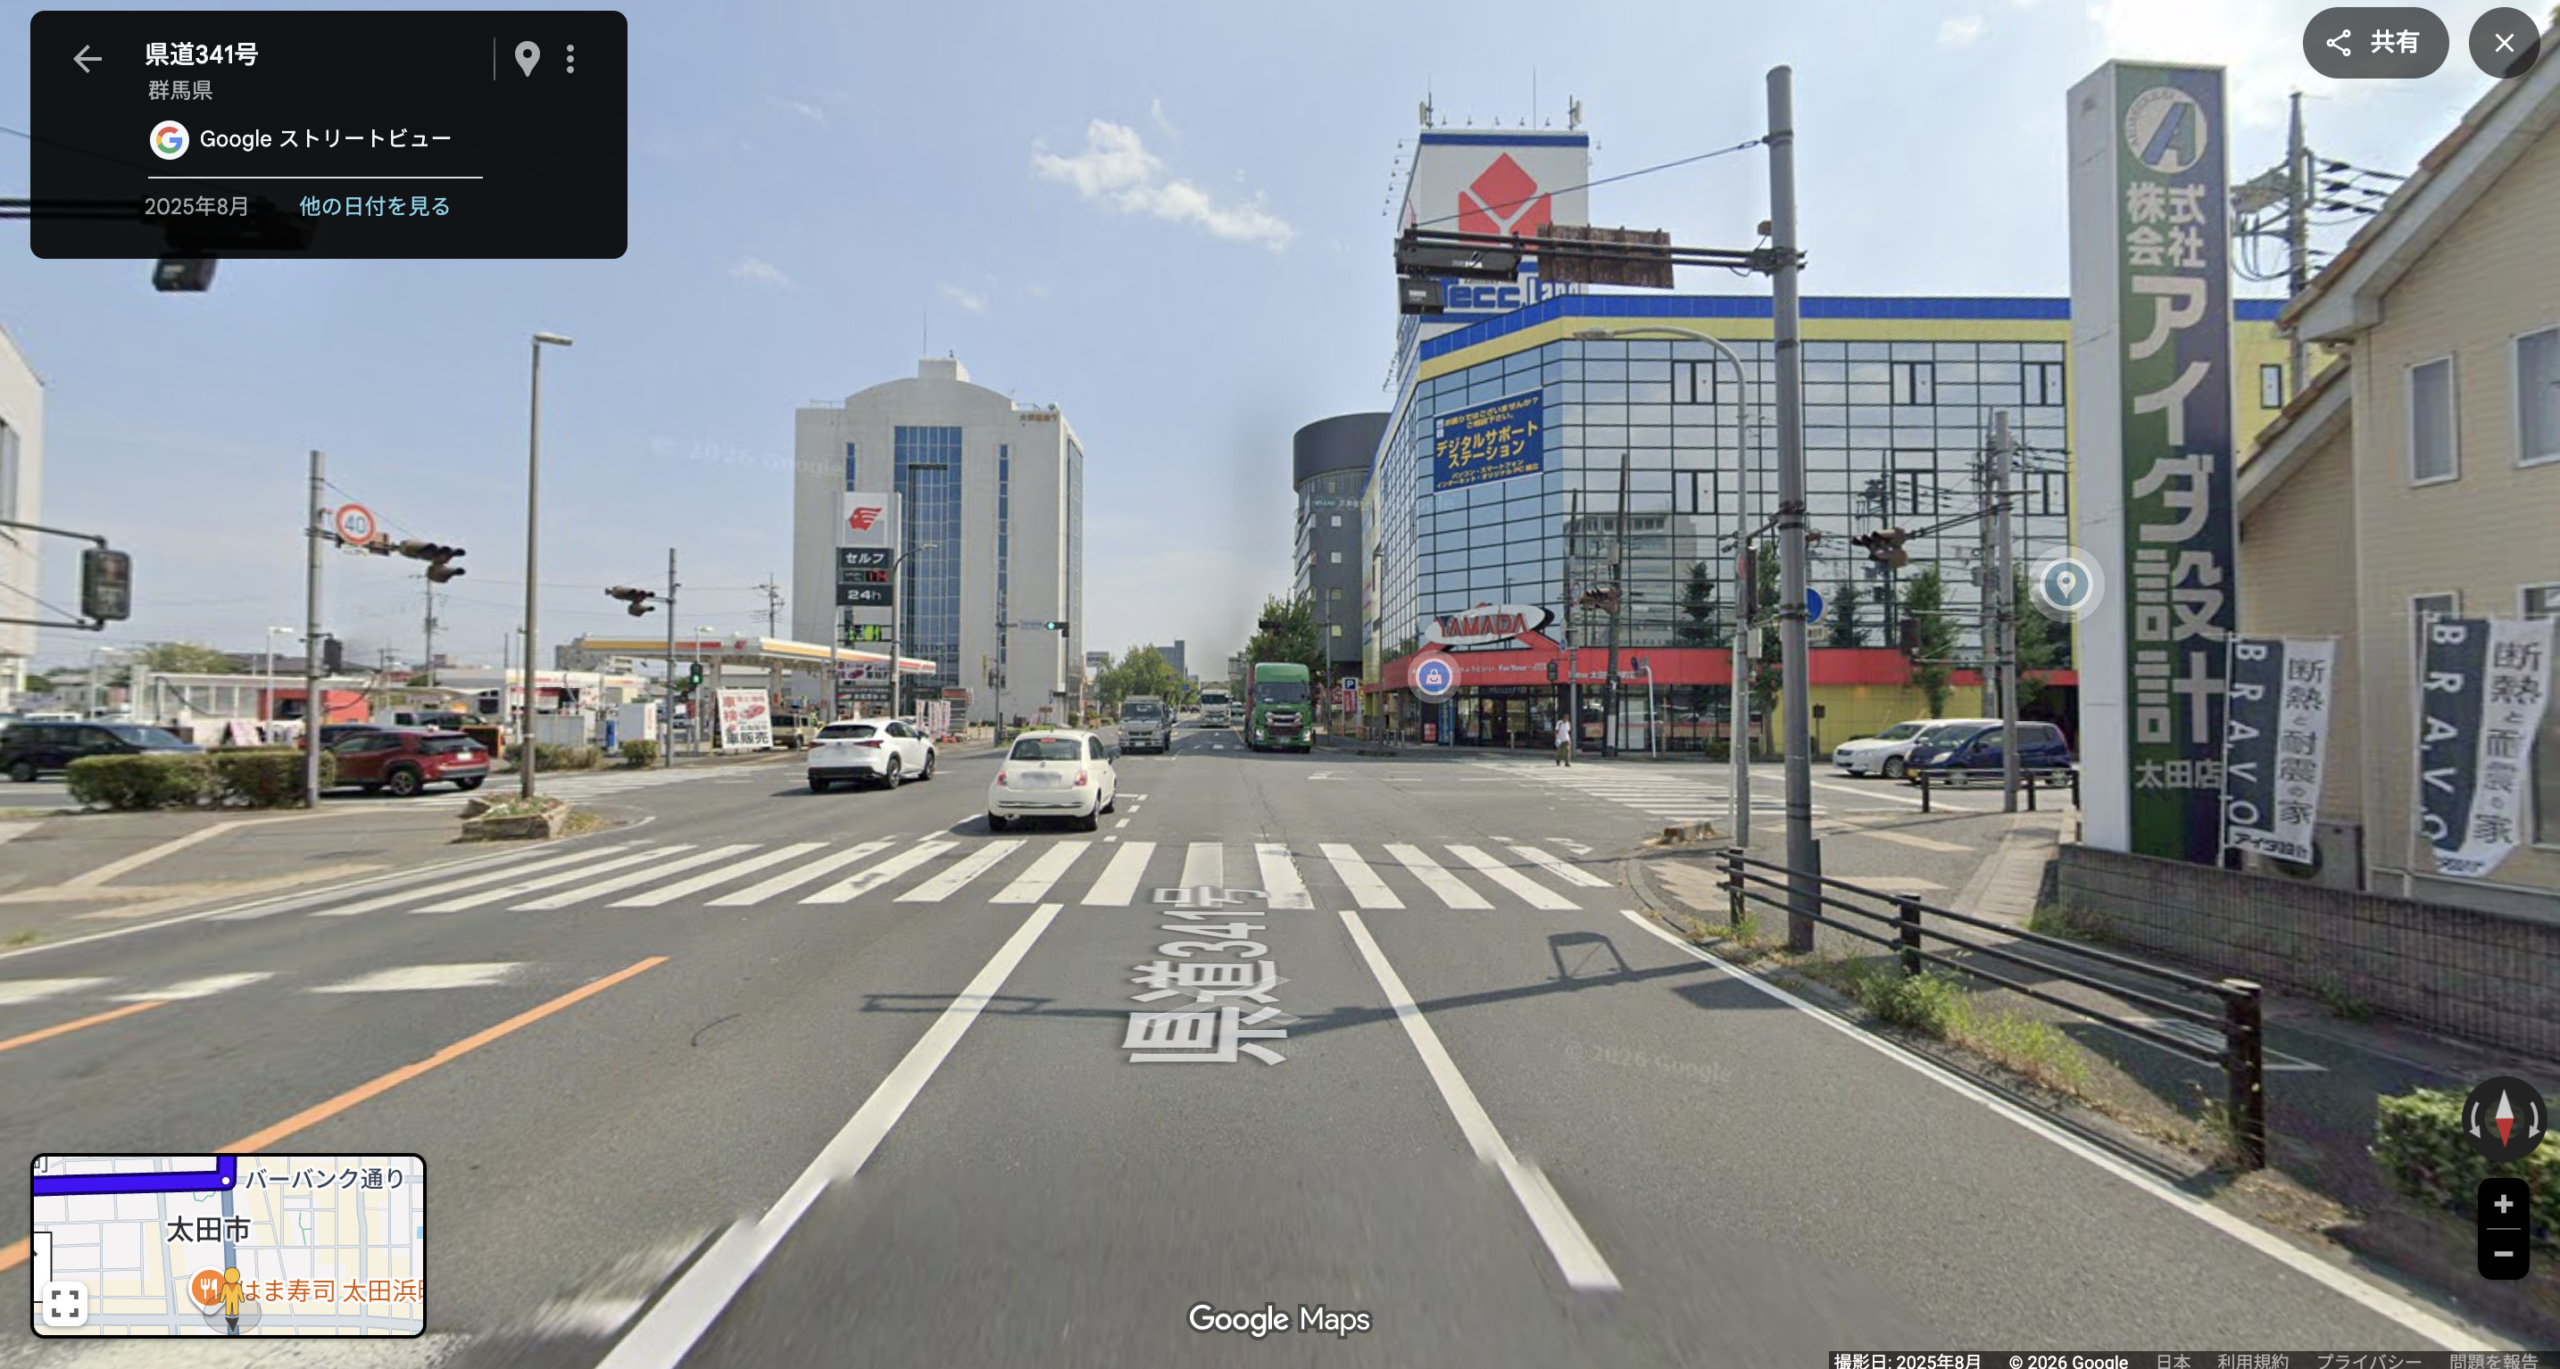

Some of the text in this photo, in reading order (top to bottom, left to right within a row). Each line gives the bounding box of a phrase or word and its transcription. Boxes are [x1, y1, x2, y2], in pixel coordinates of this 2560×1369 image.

[2127, 181, 2206, 226] 株式
[2126, 226, 2206, 269] 会社
[1436, 420, 1538, 458] デジタルサポート
[1448, 440, 1525, 469] ステーション
[345, 514, 367, 534] 40
[2129, 276, 2228, 744] アイダ設計
[845, 552, 885, 565] セルフ
[847, 589, 882, 601] 24h
[1436, 612, 1531, 638] YAMADA
[2228, 645, 2268, 826] BRAVO
[2279, 658, 2326, 826] 断熱と耐震の家
[2135, 759, 2223, 789] 太田店
